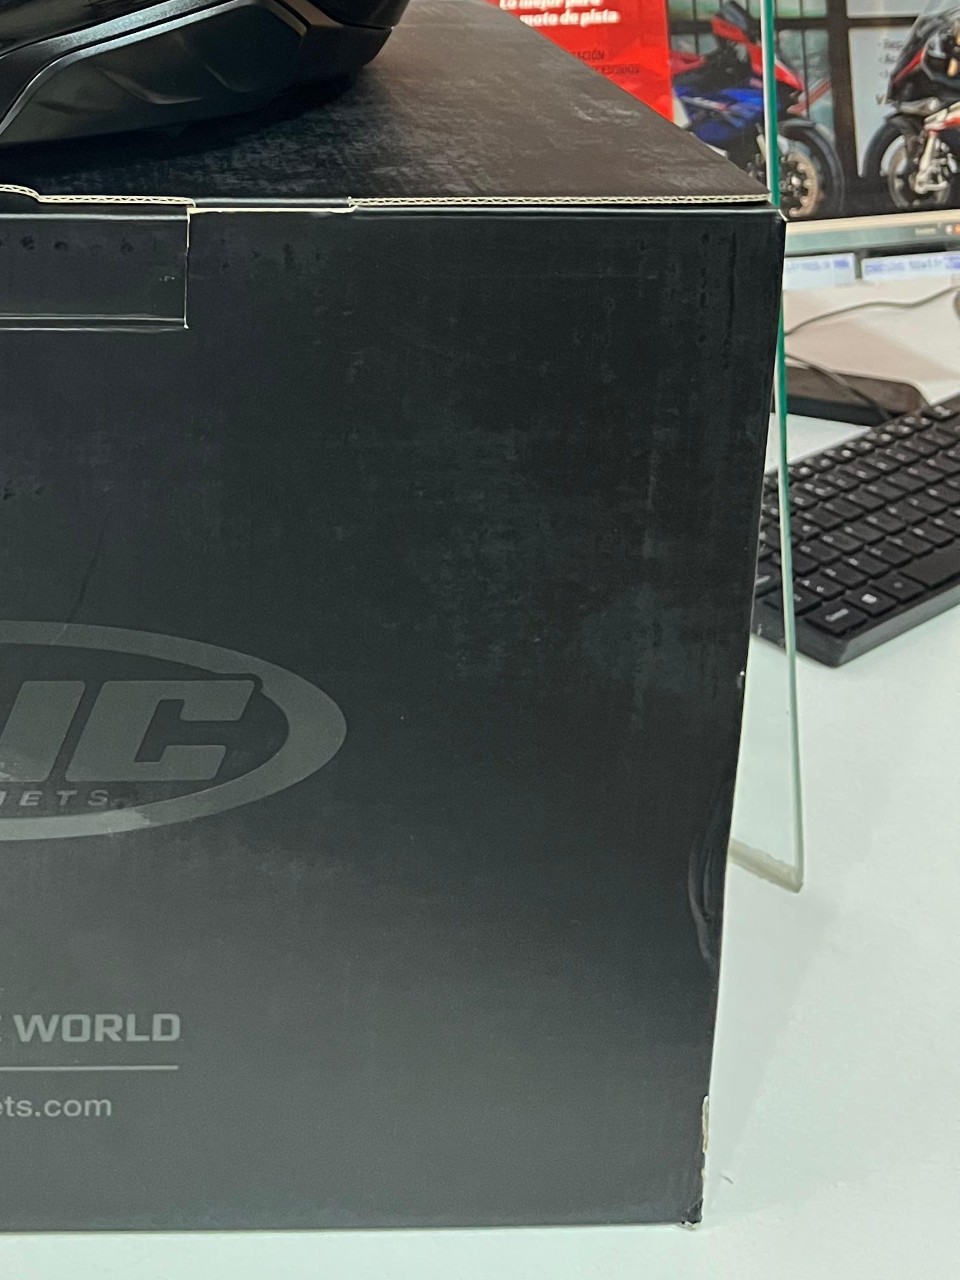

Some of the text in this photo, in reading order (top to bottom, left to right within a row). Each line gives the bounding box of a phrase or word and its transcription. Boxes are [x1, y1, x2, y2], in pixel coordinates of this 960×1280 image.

[559, 9, 578, 26] de
[579, 8, 621, 28] pista
[13, 1013, 182, 1043] WORLD
